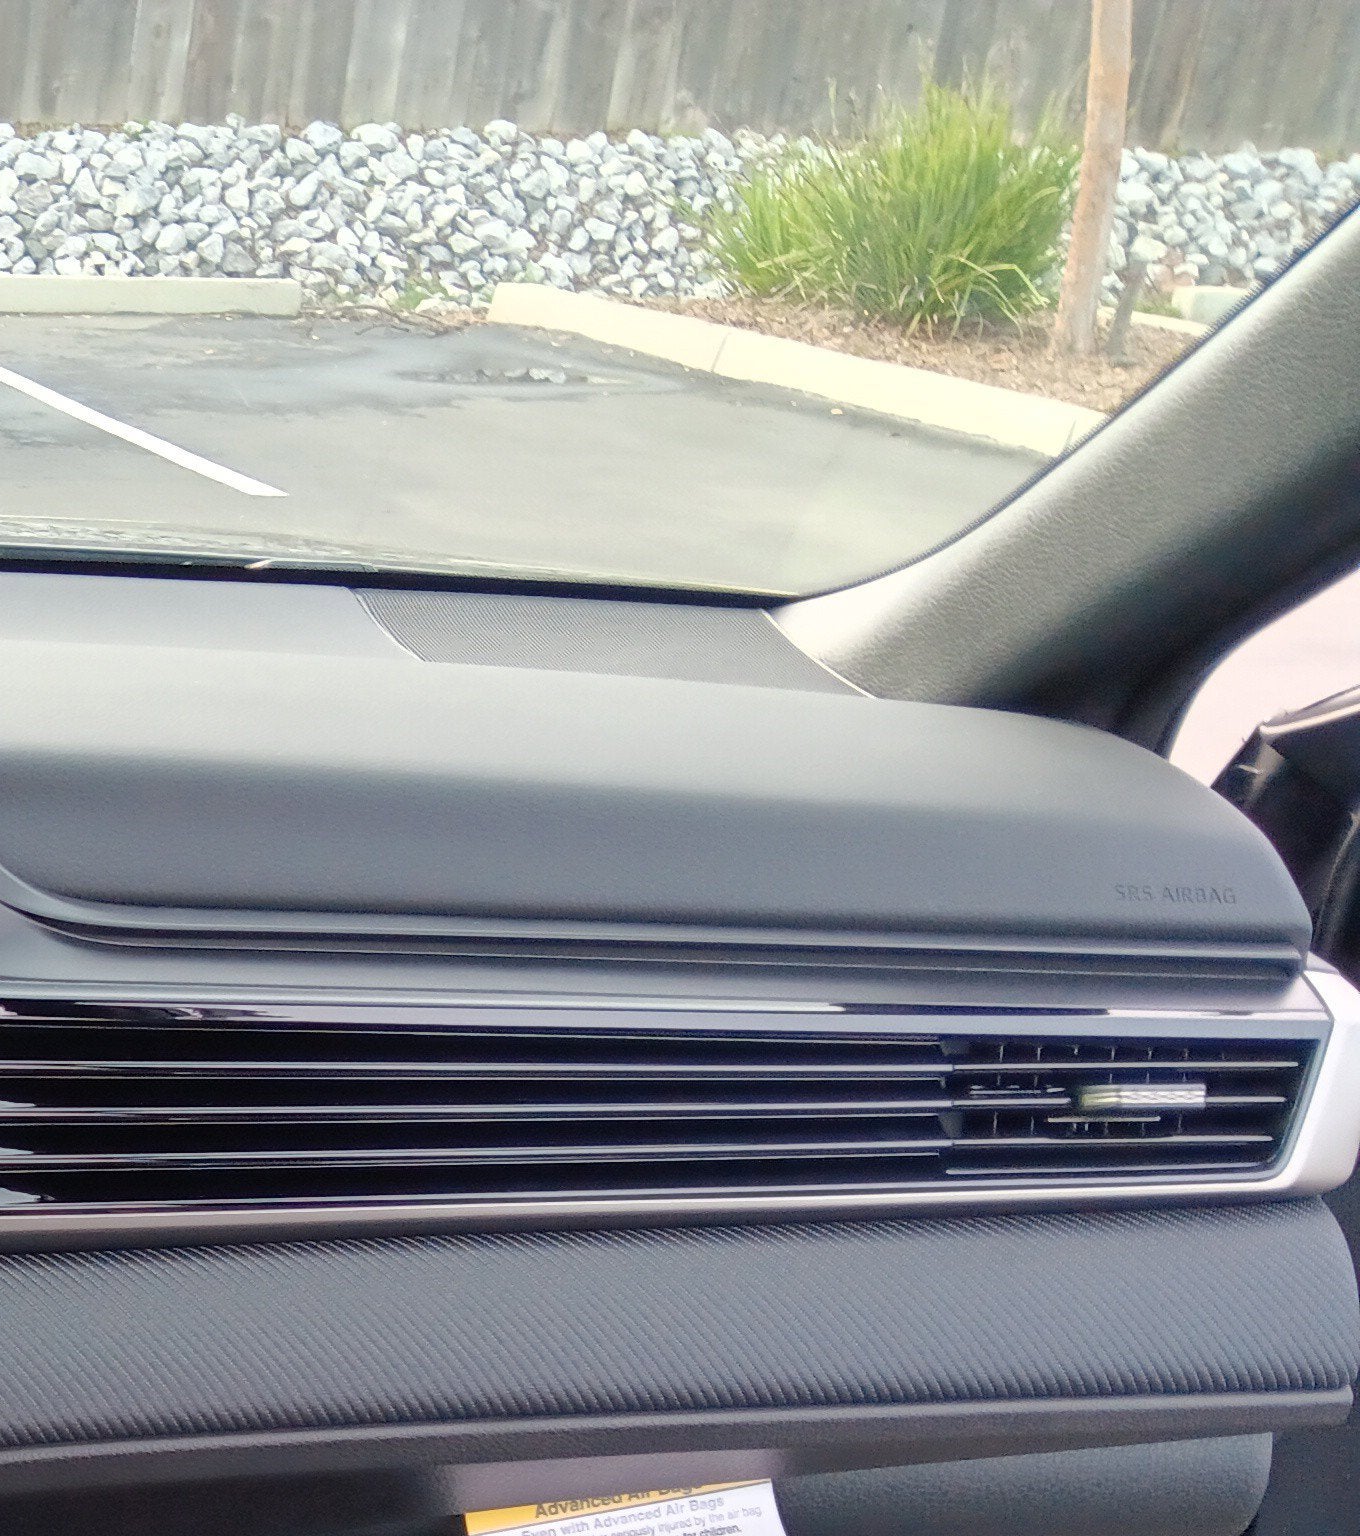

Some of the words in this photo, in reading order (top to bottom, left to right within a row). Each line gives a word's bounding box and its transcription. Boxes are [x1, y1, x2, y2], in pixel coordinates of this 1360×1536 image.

[560, 1521, 589, 1535] with
[594, 1507, 662, 1529] Advanced
[666, 1502, 685, 1516] Air
[689, 1497, 725, 1511] Bags
[693, 1516, 706, 1527] by
